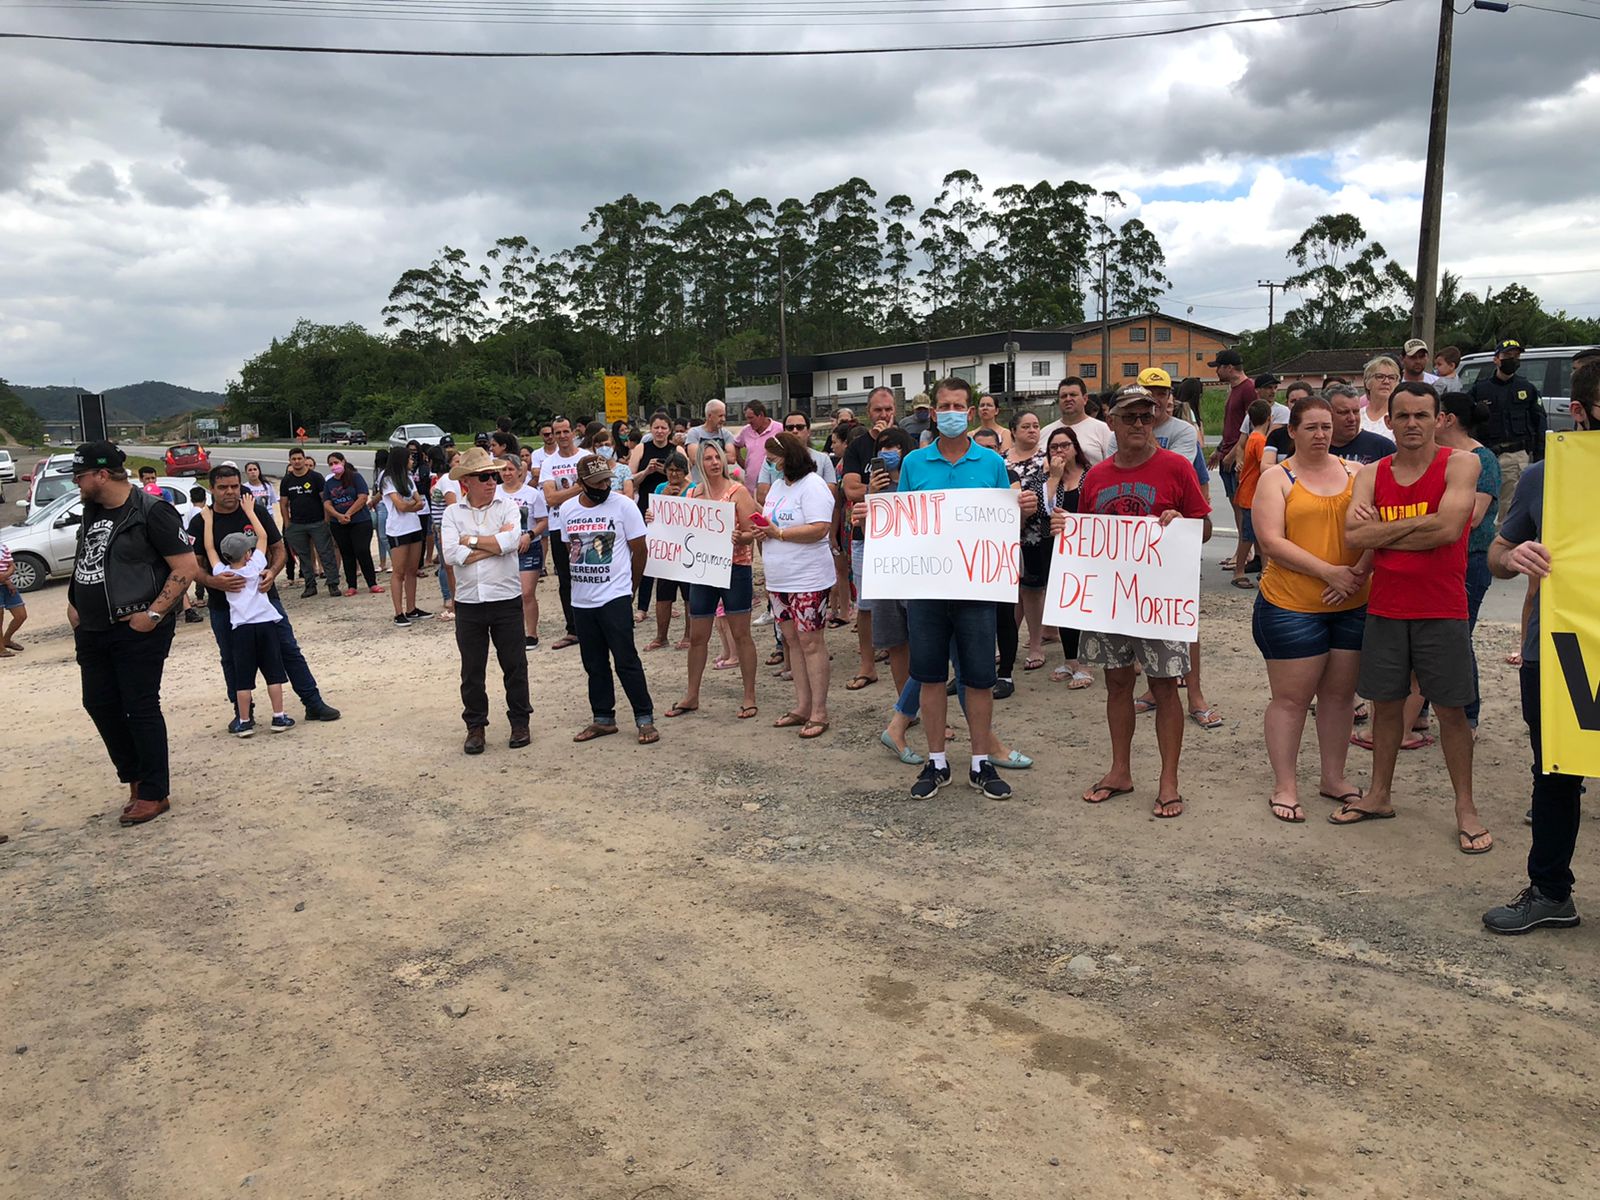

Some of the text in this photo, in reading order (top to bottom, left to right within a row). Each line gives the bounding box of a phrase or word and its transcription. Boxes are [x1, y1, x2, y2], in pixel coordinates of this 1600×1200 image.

[566, 517, 594, 525] CHEGA
[566, 523, 608, 532] MORTES!
[652, 499, 726, 534] MORADORES
[777, 512, 795, 521] AZUL
[869, 493, 1016, 539] DNIT ESTAMOS
[648, 538, 682, 563] PEDEM
[1058, 515, 1164, 567] REDUTOR
[873, 539, 1021, 586] PERDENDO VIDAS
[1059, 572, 1099, 614] DE
